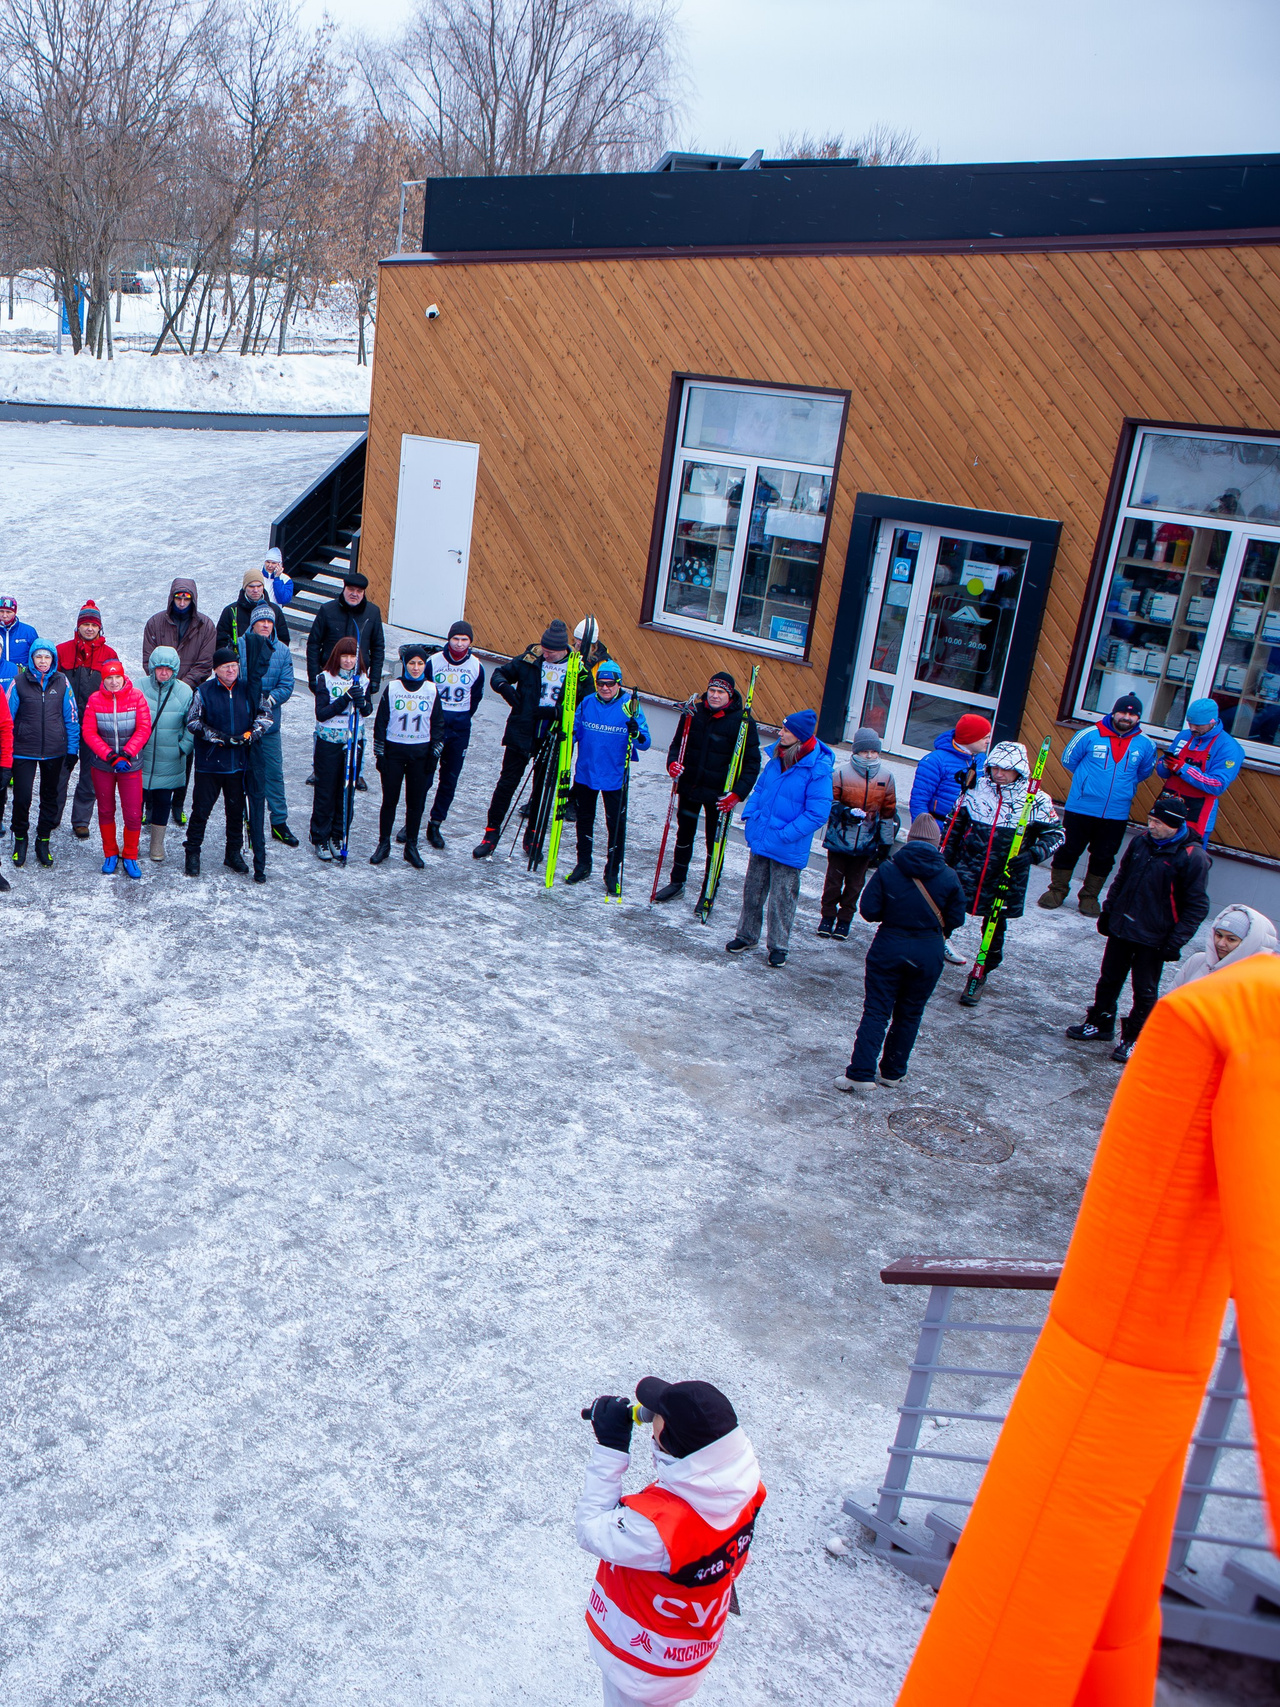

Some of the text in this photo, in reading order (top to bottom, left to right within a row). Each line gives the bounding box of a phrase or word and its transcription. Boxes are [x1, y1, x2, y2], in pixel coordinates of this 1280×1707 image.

[945, 636, 962, 646] 10.00
[968, 641, 987, 651] 20.00
[440, 686, 465, 702] 49
[398, 713, 422, 732] 11
